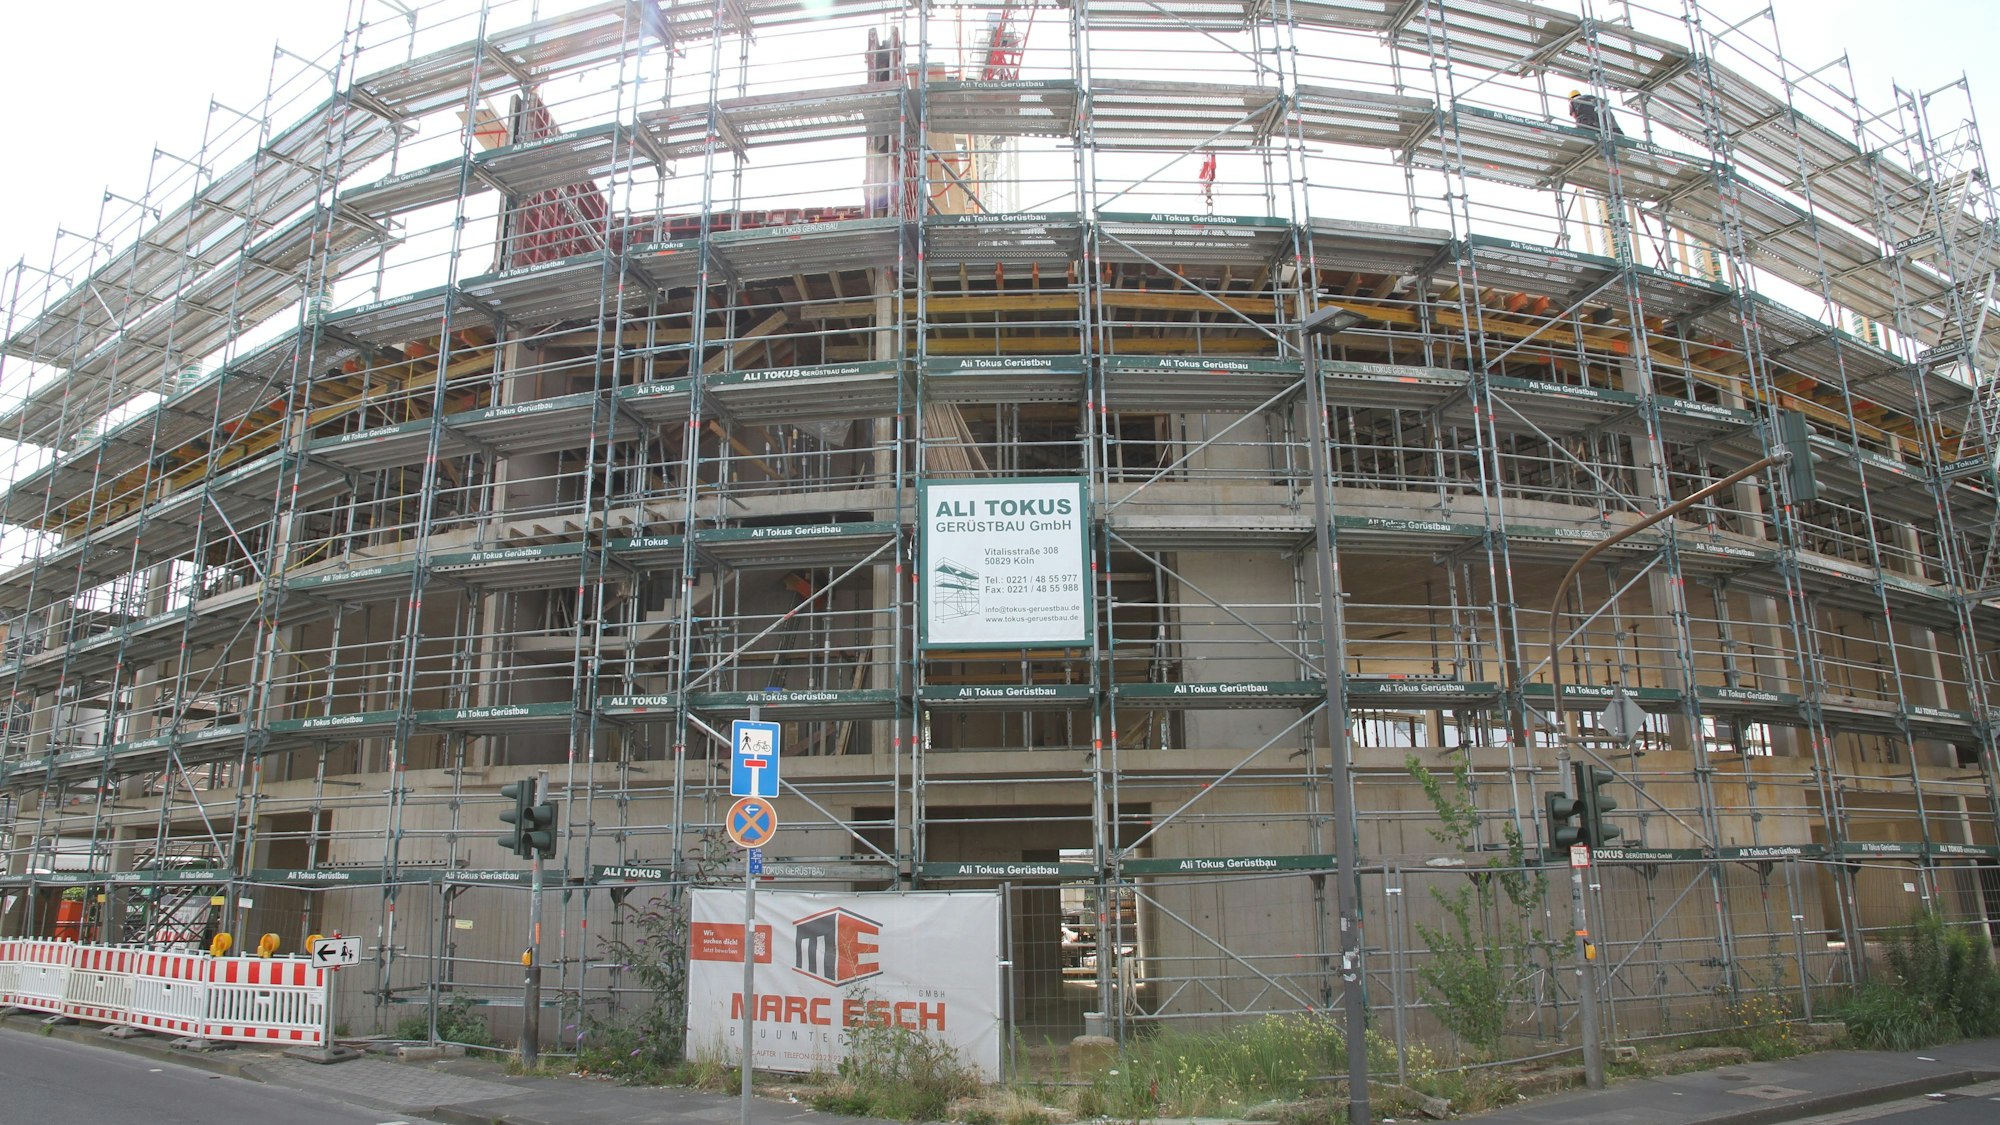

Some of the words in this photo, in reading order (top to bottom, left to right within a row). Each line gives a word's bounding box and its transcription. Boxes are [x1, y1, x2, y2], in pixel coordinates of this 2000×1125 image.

[523, 138, 543, 148] Tokus
[1636, 142, 1646, 150] ALI
[1648, 145, 1673, 156] TOKUS
[383, 176, 401, 185] Tokus
[1898, 240, 1908, 248] Ali
[1910, 232, 1932, 244] Tokus
[1522, 243, 1542, 252] Tokus
[1543, 245, 1579, 258] Gerüstbau
[510, 266, 530, 275] Tokus
[531, 259, 566, 271] Gerüstbau
[1663, 270, 1680, 280] Tokus
[1680, 275, 1711, 288] Gerüstbau
[365, 299, 383, 310] Tokus
[383, 293, 415, 306] Gerüstbau
[1004, 358, 1052, 366] Gerüstbau
[744, 371, 762, 379] ALI
[764, 369, 801, 378] TOKUS
[637, 386, 649, 394] Ali
[651, 383, 676, 393] Tokus
[1541, 383, 1562, 391] Tokus
[1562, 385, 1598, 396] Gerüstbau
[517, 401, 554, 412] Gerüstbau
[1674, 399, 1682, 407] Ali
[1683, 401, 1701, 410] Tokus
[1701, 404, 1733, 415] Gerüstbau
[351, 431, 369, 439] Tokus
[369, 425, 401, 436] Gerüstbau
[1944, 463, 1955, 471] Ali
[1957, 457, 1979, 468] Tokus
[936, 501, 976, 517] ALI
[985, 498, 1071, 517] TOKUS
[795, 525, 842, 534] Gerüstbau
[936, 520, 1025, 533] GERÜSTBAU
[1030, 519, 1071, 532] GmbH
[1408, 521, 1452, 530] Gerüstbau
[483, 551, 504, 559] Tokus
[505, 547, 542, 557] Gerüstbau
[985, 547, 1040, 555] Vitalisstraße
[1706, 544, 1724, 552] Tokus
[1724, 546, 1756, 556] Gerüstbau
[332, 571, 350, 580] Tokus
[351, 566, 383, 577] Gerüstbau
[986, 605, 1080, 614] info@tokus-geruestbau.de
[986, 615, 1078, 623] www.tokus-geruestbau.de
[1006, 687, 1057, 695] Gerüstbau
[1219, 684, 1269, 692] Gerüstbau
[1420, 683, 1465, 691] Gerüstbau
[1578, 686, 1600, 694] Tokus
[790, 692, 839, 700] Gerüstbau
[1718, 689, 1726, 697] Ali
[1728, 689, 1746, 698] Tokus
[1747, 691, 1779, 700] Gerüstbau
[469, 709, 491, 717] Tokus
[491, 706, 529, 716] Gerüstbau
[332, 715, 364, 724] Gerüstbau
[1593, 850, 1625, 858] TOKUS
[1769, 846, 1802, 854] Gerüstbau
[1180, 860, 1194, 868] Ali
[1196, 860, 1225, 868] Tokus
[1226, 858, 1277, 867] Gerüstbau
[603, 867, 621, 875] ALI
[624, 869, 662, 877] TOKUS
[959, 865, 974, 873] Ali
[976, 865, 1006, 873] Tokus
[1007, 865, 1060, 874] Gerüstbau
[445, 871, 455, 879] Ali
[457, 871, 480, 879] Tokus
[481, 871, 520, 879] Gerüstbau
[731, 993, 831, 1025] MARC
[843, 999, 945, 1031] ESCH
